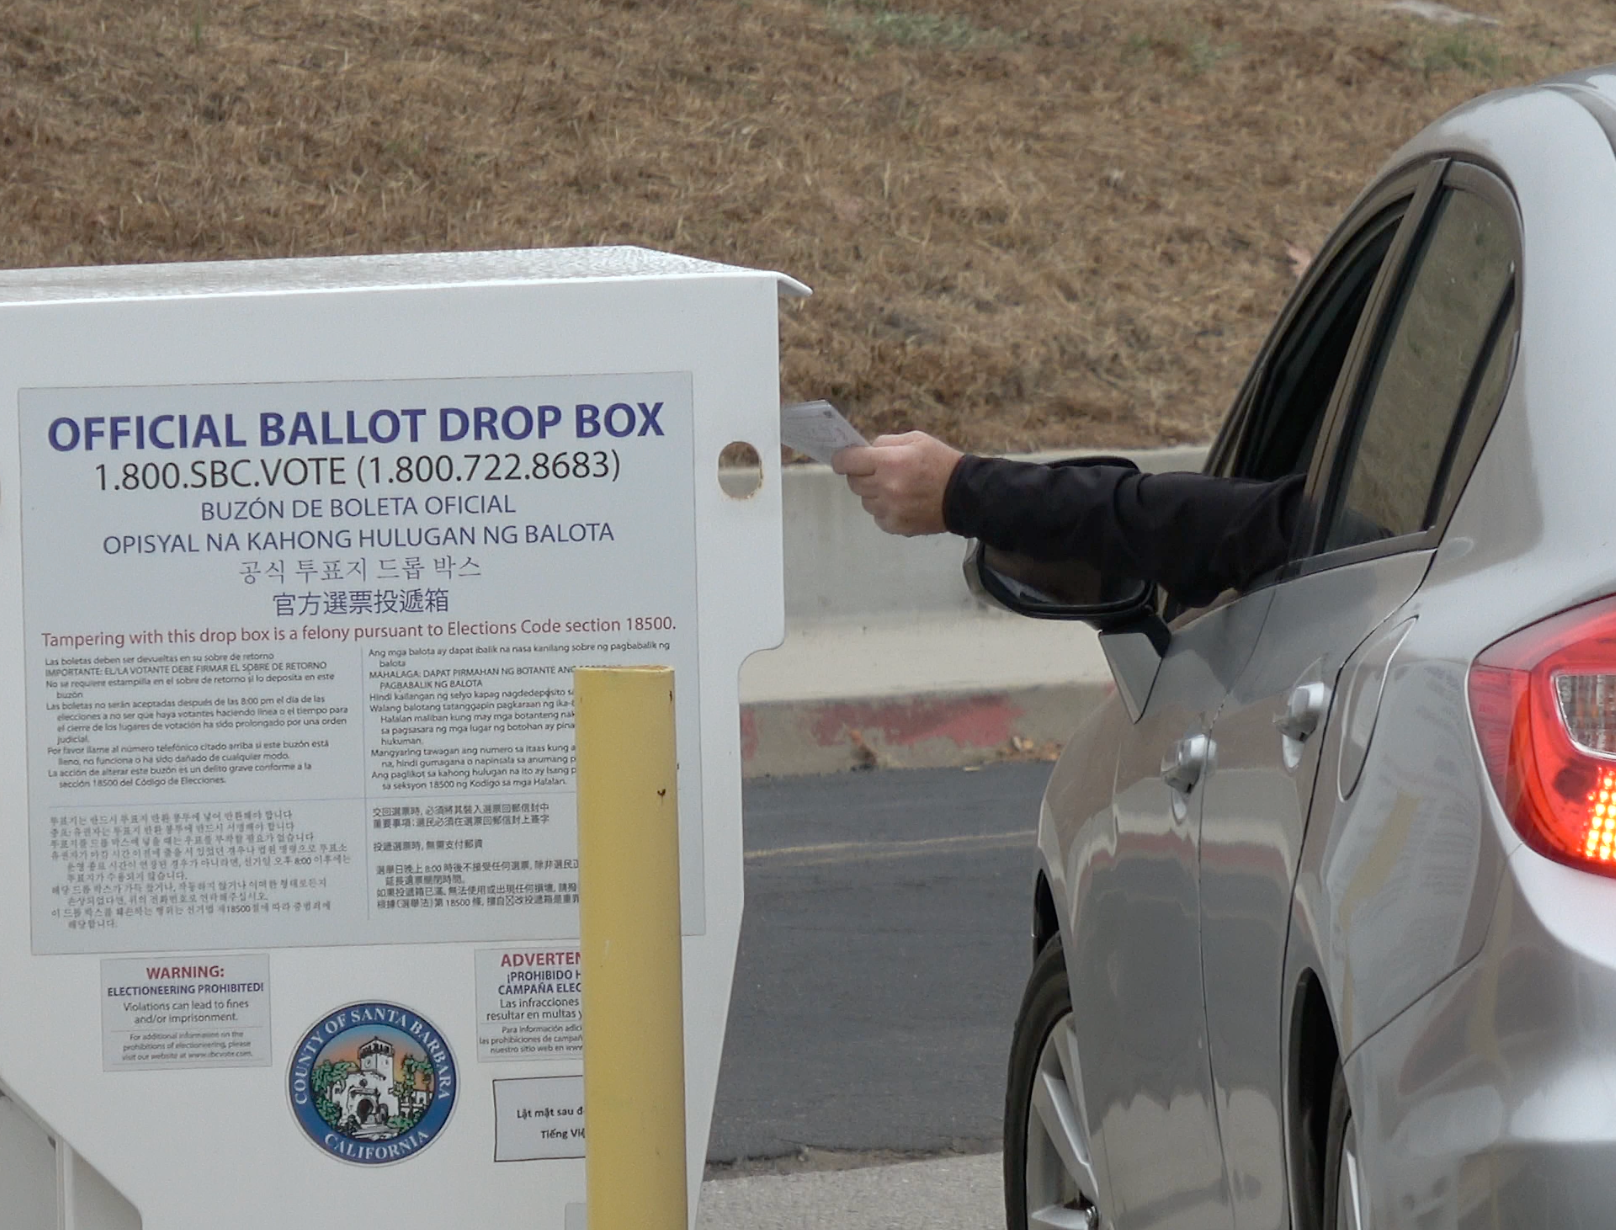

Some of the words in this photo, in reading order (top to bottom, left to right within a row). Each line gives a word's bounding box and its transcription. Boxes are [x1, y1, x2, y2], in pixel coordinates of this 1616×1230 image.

[48, 413, 246, 450] OFFICIAL
[259, 408, 425, 445] BALLOT
[439, 405, 561, 441] DROP
[575, 402, 665, 437] BOX
[95, 457, 345, 490] 1.800.SBC.VOTE
[357, 451, 619, 490] (1.800.722.8683)
[201, 495, 284, 520] BUZÓN
[292, 499, 323, 518] DE
[330, 496, 418, 517] BOLETA
[424, 494, 515, 515] OFICIAL
[104, 532, 198, 554] OPISYAL
[206, 531, 240, 551] NA
[247, 528, 351, 550] KAHONG
[358, 525, 475, 547] HULUGAN
[483, 524, 517, 544] NG
[525, 522, 613, 543] BALOTA
[239, 559, 287, 585] 공식
[294, 557, 368, 583] 투표지
[376, 556, 426, 581] 드롭
[433, 555, 482, 580] 박스
[272, 587, 450, 616] 官方選票投遞箱
[42, 630, 125, 650] Tampering
[129, 629, 163, 644] with
[167, 629, 195, 643] this
[199, 628, 236, 646] drop
[240, 627, 269, 641] box
[273, 626, 285, 641] is
[289, 629, 297, 640] a
[302, 625, 349, 643] felony
[353, 623, 423, 642] pursuant
[427, 622, 443, 637] to
[447, 620, 516, 636] Elections
[520, 619, 561, 634] Code
[565, 618, 620, 633] section
[627, 616, 676, 631] 18500.
[46, 656, 59, 665] Las
[60, 655, 92, 665] boletas
[93, 654, 121, 664] deben
[136, 653, 178, 663] devueltas
[204, 652, 228, 662] sobre
[229, 652, 241, 661] de
[242, 651, 274, 661] retorno
[379, 658, 406, 667] balota
[129, 665, 170, 674] VOTANTE
[171, 664, 194, 674] DEBE
[195, 663, 228, 673] FIRMAR
[229, 663, 239, 672] EL
[271, 662, 283, 671] DE
[285, 661, 327, 671] RETORNO
[422, 667, 450, 677] DAPAT
[452, 666, 499, 676] PIRMAHAN
[500, 666, 515, 675] NG
[516, 665, 556, 675] BOTANTE
[380, 679, 432, 689] PAGBABALIK
[434, 679, 448, 688] NG
[449, 678, 483, 688] BALOTA
[56, 689, 83, 699] buzón
[59, 778, 90, 788] sección
[92, 778, 118, 787] 18500
[119, 777, 133, 787] del
[134, 776, 166, 789] Código
[167, 776, 179, 785] de
[146, 965, 224, 979] WARNING:
[507, 970, 573, 983] ¡PROHIBIDO
[107, 984, 195, 996] ELECTIONEERING
[197, 982, 264, 994] PROHIBITED!
[498, 981, 553, 995] CAMPAÑA
[123, 1001, 170, 1011] Violations
[171, 1002, 189, 1010] can
[190, 1000, 212, 1010] lead
[213, 999, 224, 1009] to
[225, 999, 249, 1009] fines
[500, 998, 516, 1008] Las
[518, 997, 579, 1008] infracciones
[134, 1013, 166, 1024] and/or
[168, 1011, 237, 1025] imprisonment.
[486, 1010, 524, 1021] resultar
[526, 1012, 540, 1020] en
[541, 1009, 576, 1019] multas
[294, 1031, 325, 1105] COUNTY
[325, 1013, 347, 1034] OF
[350, 1008, 407, 1028] SANTA
[410, 1020, 451, 1099] BARBARA
[557, 1108, 574, 1116] sau
[541, 1128, 568, 1139] Tiếng
[325, 1130, 429, 1159] CALIFORNIA
